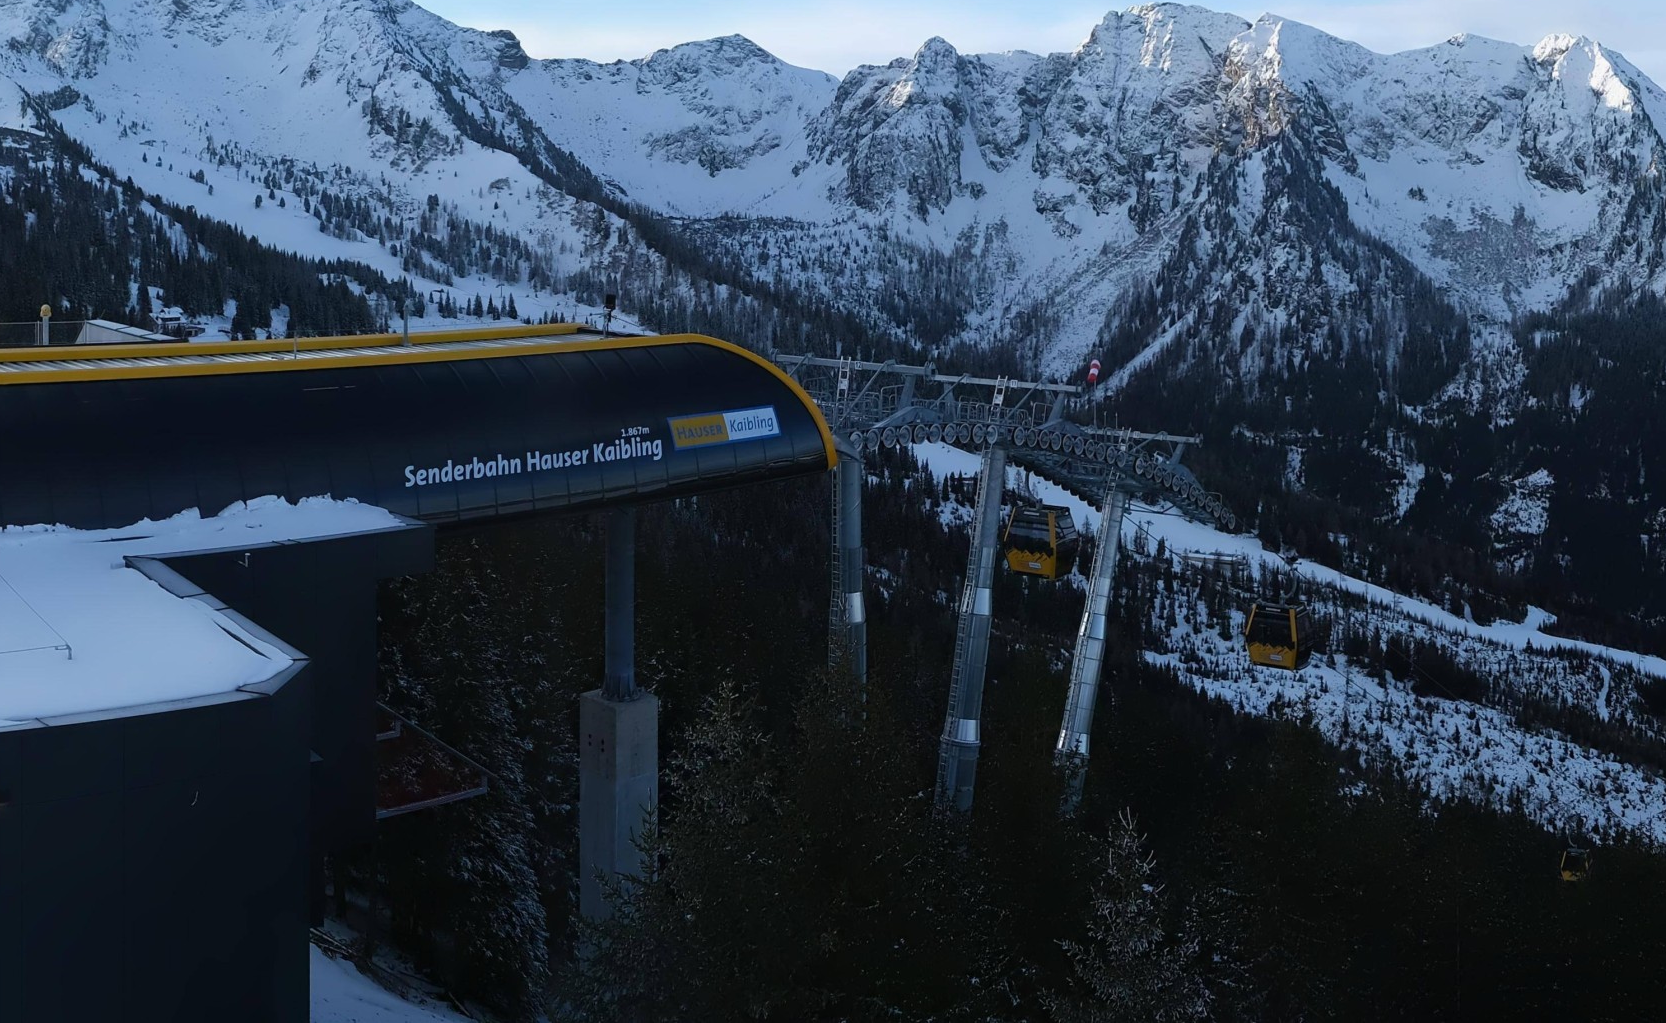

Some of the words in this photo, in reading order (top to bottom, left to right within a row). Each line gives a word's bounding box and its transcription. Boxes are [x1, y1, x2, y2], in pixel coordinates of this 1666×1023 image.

[621, 426, 650, 437] 1.867m
[676, 424, 724, 439] HAUSER
[729, 416, 774, 433] Kaibling
[404, 453, 521, 487] Senderbahn
[526, 448, 589, 472] Hauser
[592, 436, 663, 461] Kaibling
